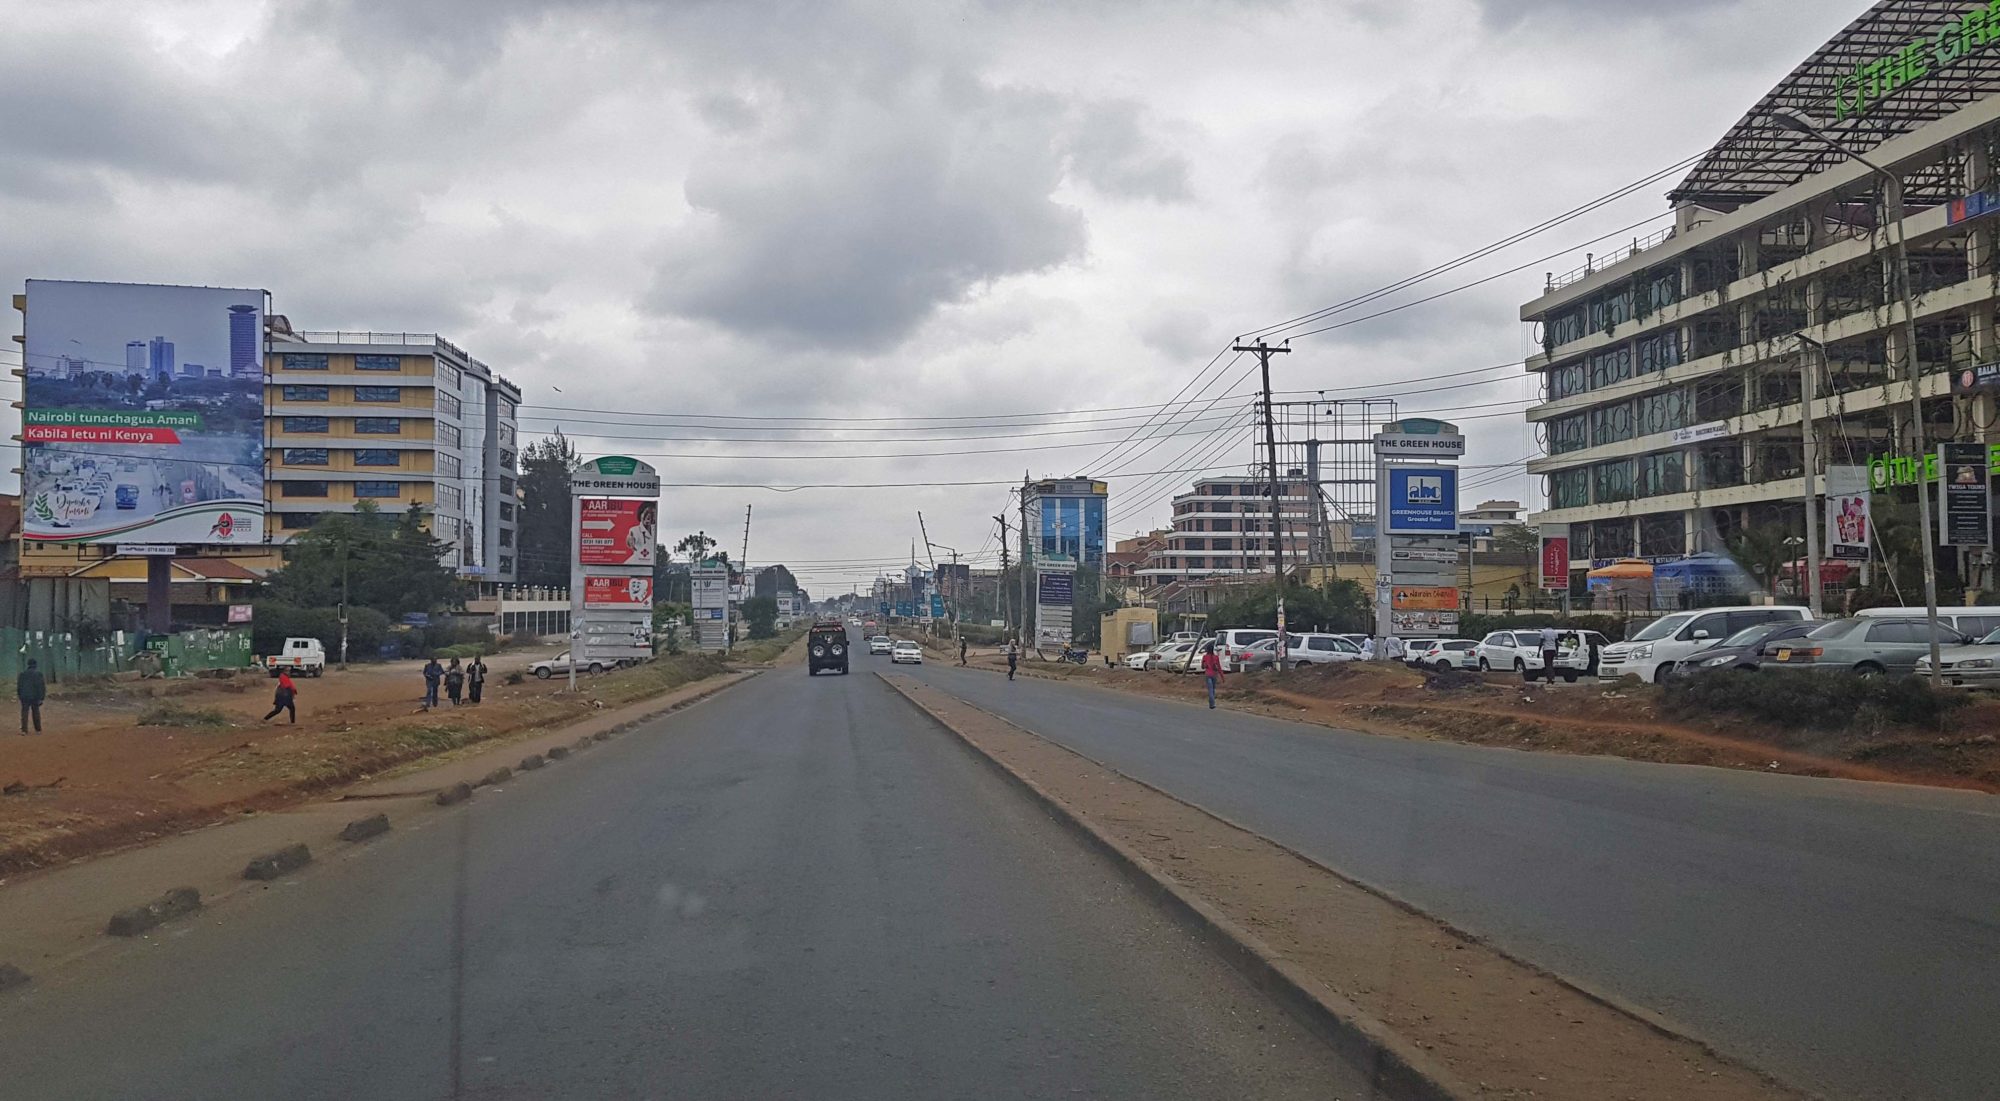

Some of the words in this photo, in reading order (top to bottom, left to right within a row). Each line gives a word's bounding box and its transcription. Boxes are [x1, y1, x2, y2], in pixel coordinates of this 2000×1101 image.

[1864, 38, 1928, 97] THE
[28, 411, 76, 422] Nairobi
[79, 412, 154, 426] tunachagua
[157, 414, 197, 425] Amani
[28, 428, 67, 439] Kabila
[71, 429, 96, 439] letu
[100, 429, 111, 439] ni
[115, 430, 153, 443] Kenya
[1400, 440, 1429, 448] GREEN
[1432, 441, 1462, 449] HOUSE
[573, 480, 590, 488] THE
[593, 481, 624, 489] GREEN
[626, 482, 657, 490] HOUSE
[1409, 478, 1441, 499] abc
